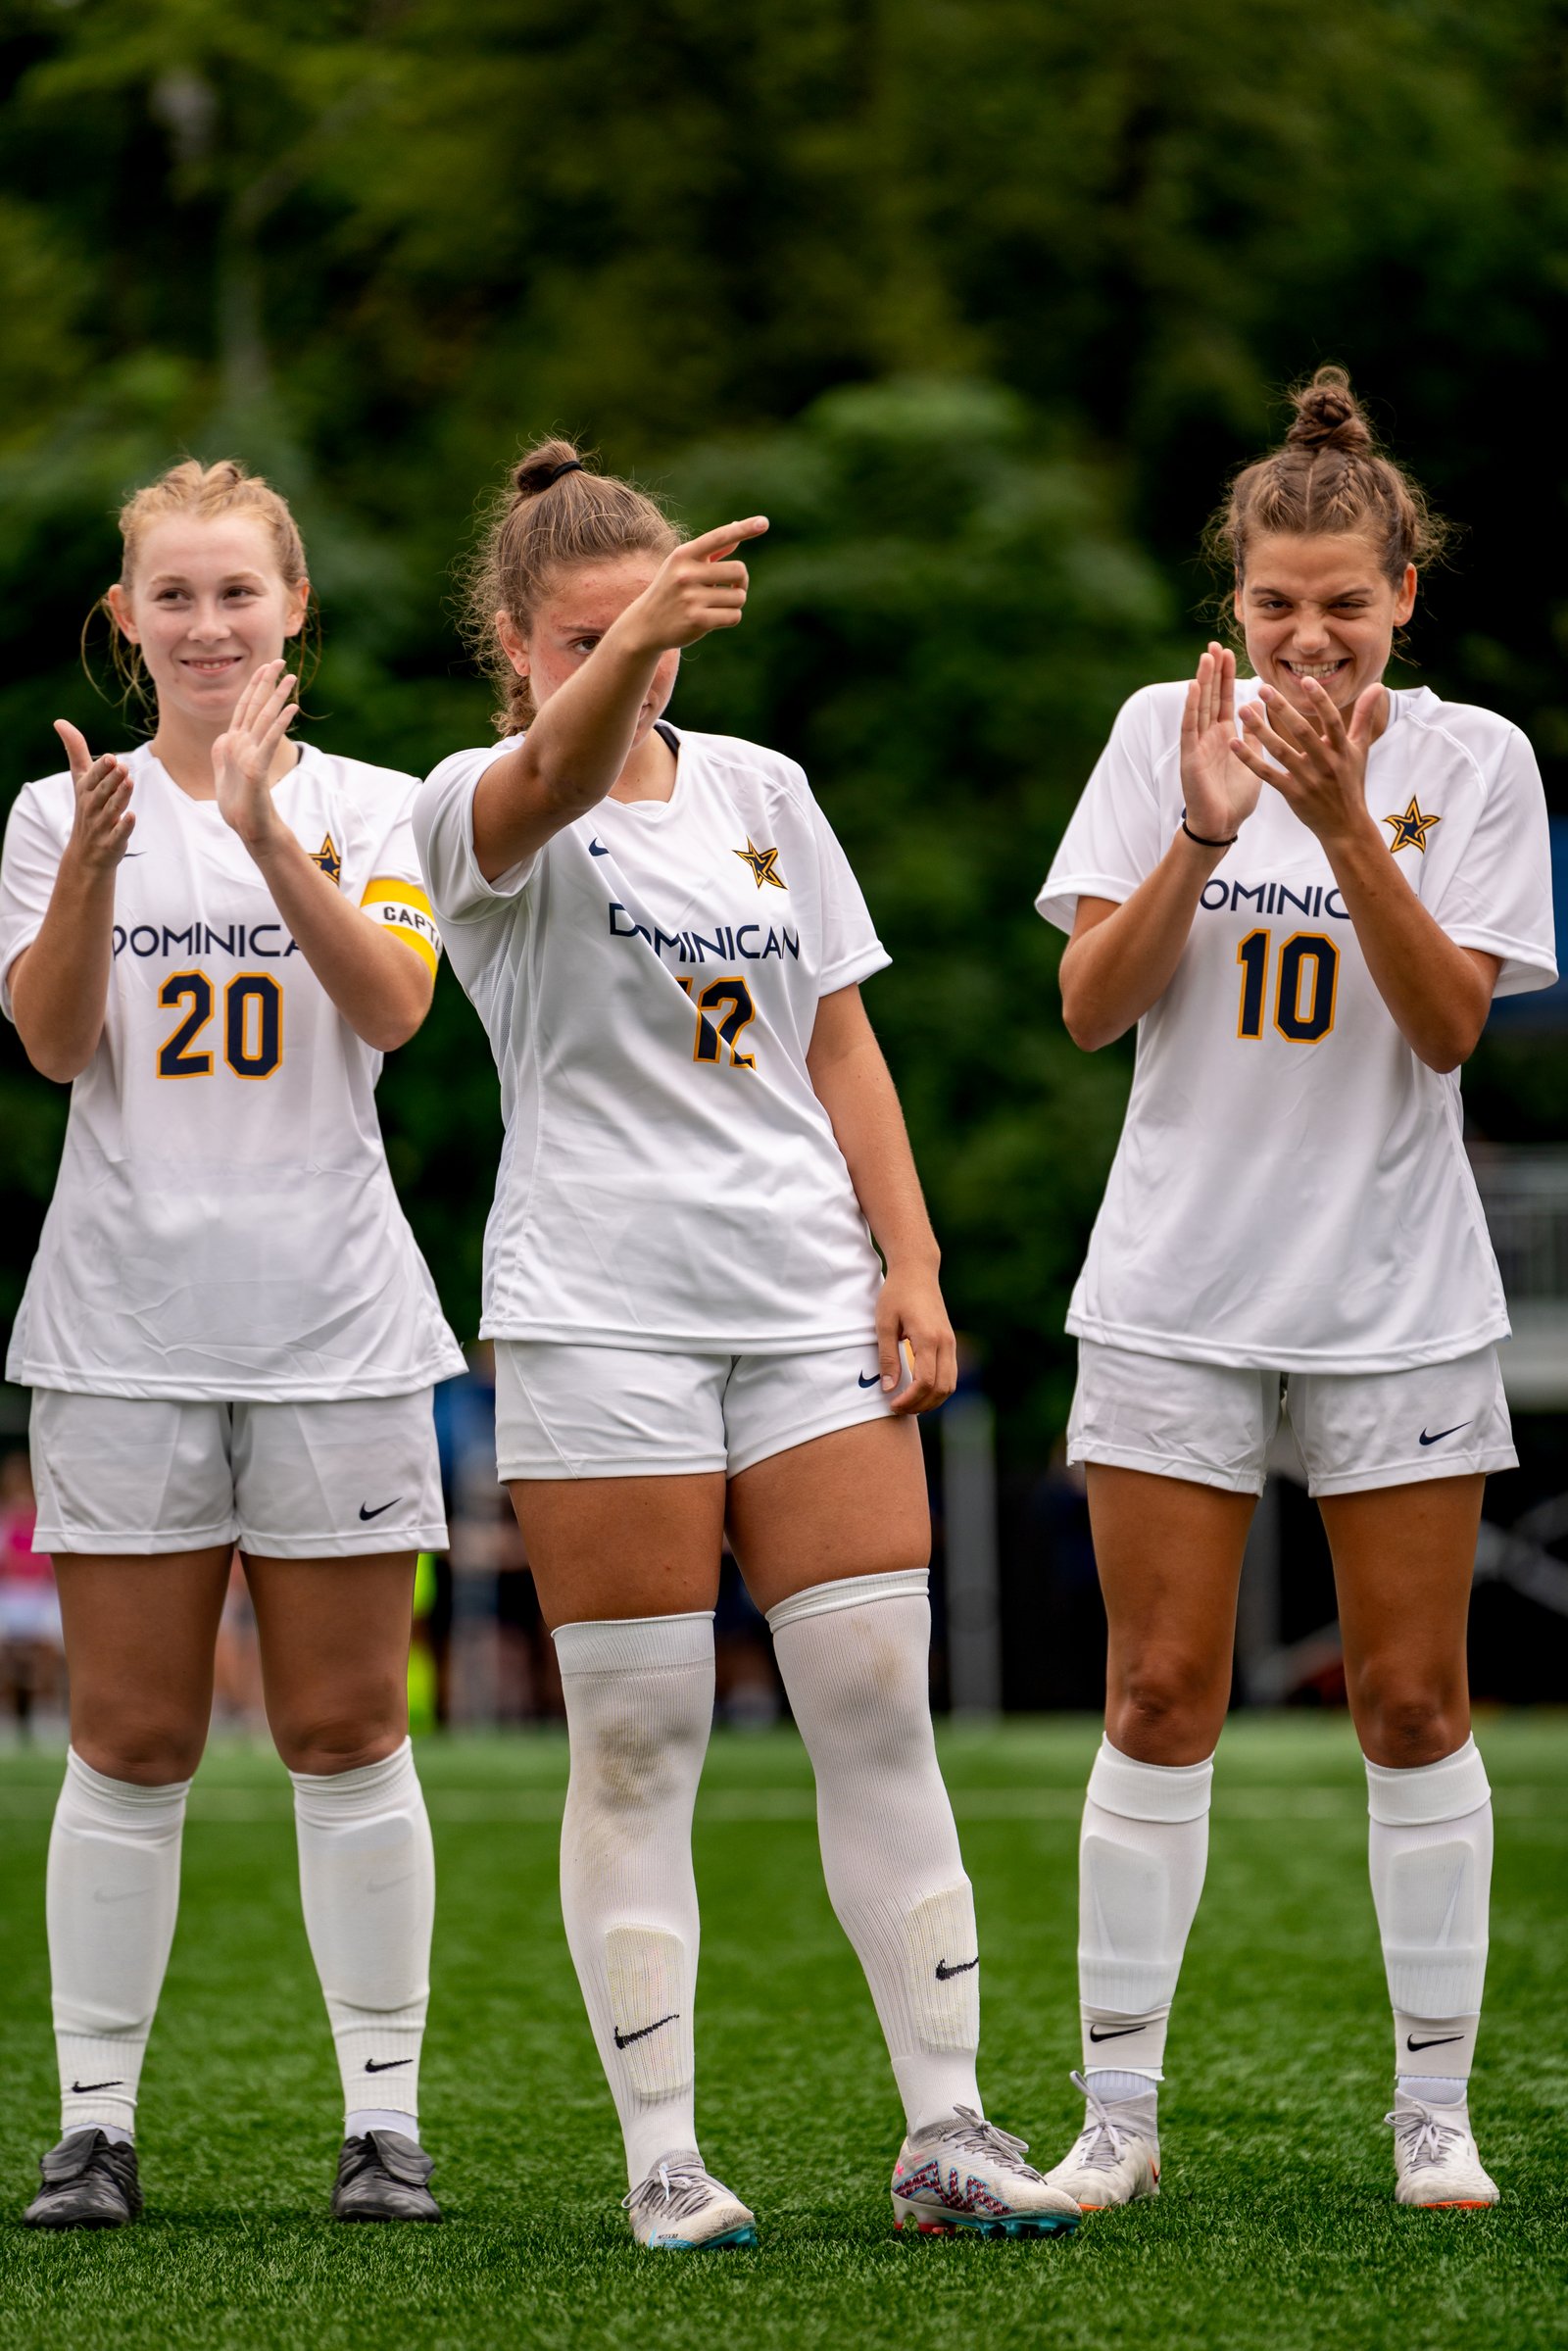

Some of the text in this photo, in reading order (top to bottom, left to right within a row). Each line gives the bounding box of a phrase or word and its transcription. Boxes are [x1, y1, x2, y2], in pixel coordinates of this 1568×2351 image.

[156, 969, 283, 1080] 20
[673, 976, 757, 1071] 12
[1237, 928, 1341, 1045] 10
